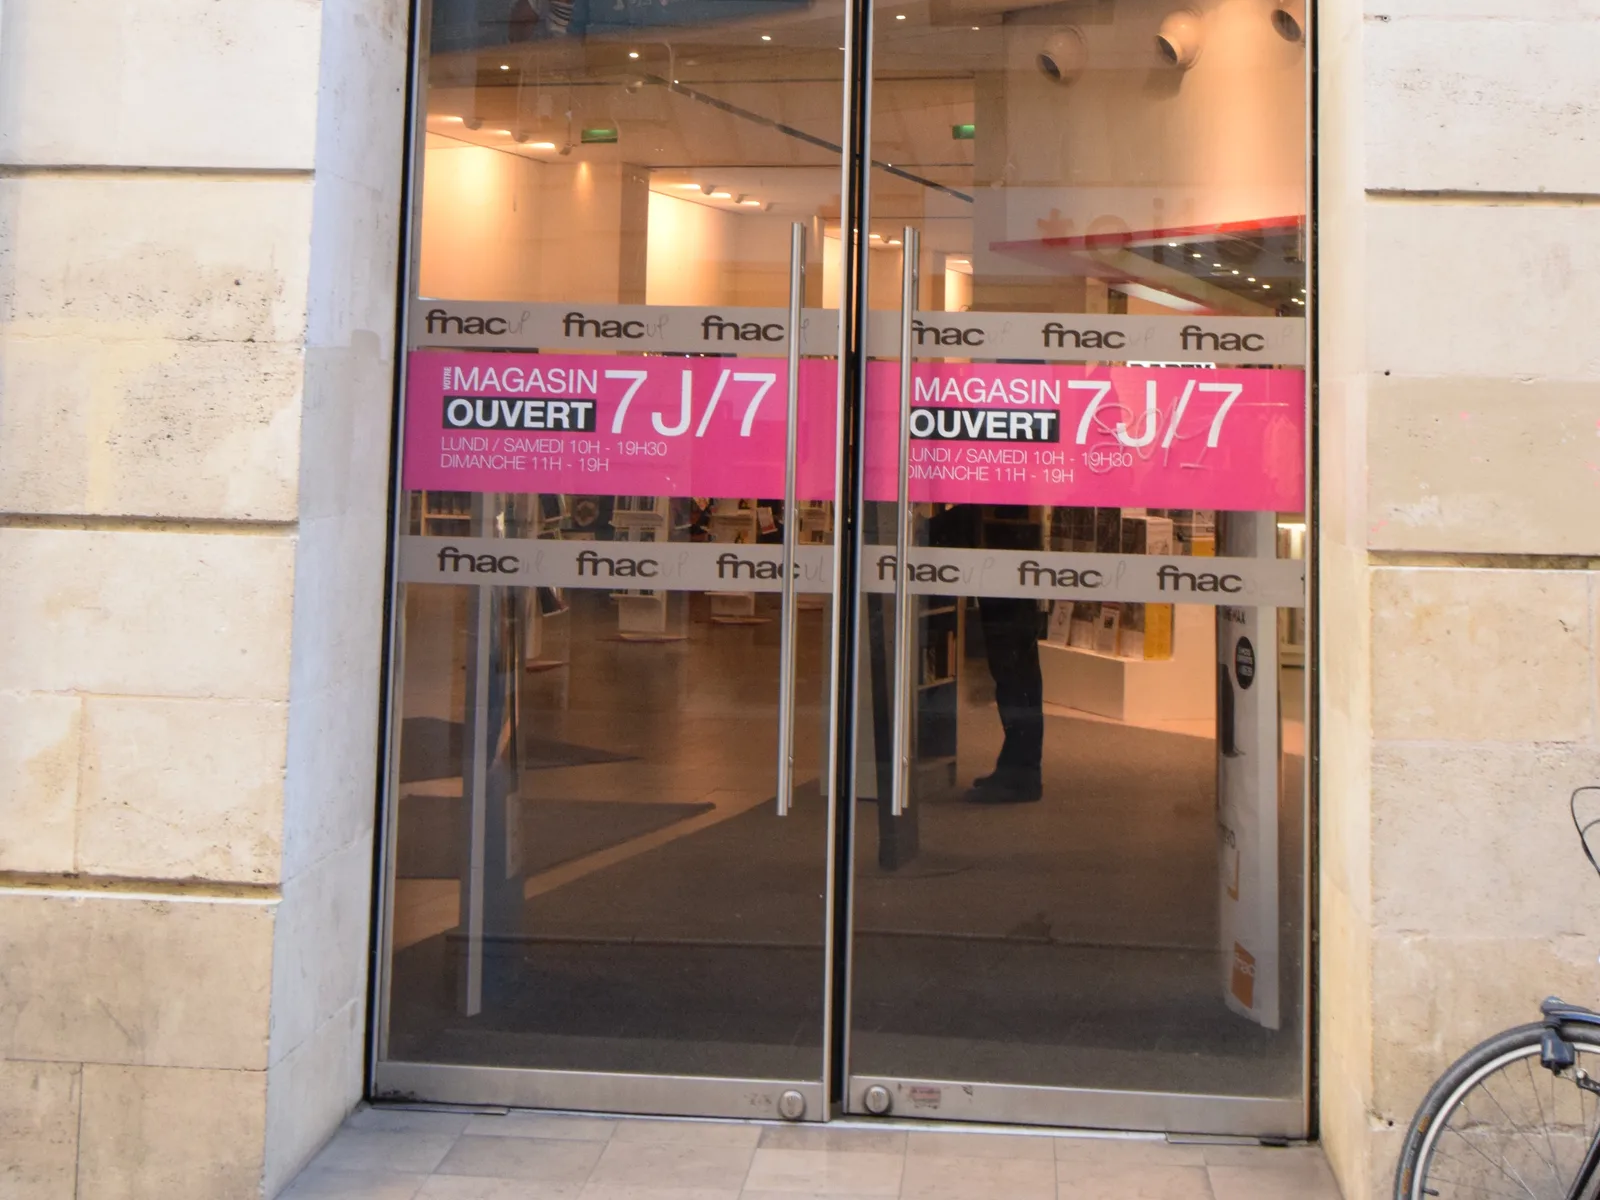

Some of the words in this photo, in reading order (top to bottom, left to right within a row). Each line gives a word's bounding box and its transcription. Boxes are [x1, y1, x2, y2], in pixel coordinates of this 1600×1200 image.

[426, 309, 507, 335] fnac
[562, 311, 645, 339] fnac
[701, 315, 784, 341] fnac
[1042, 322, 1125, 349] fnac
[1180, 325, 1264, 352] fnac
[443, 366, 452, 390] VOTRE
[453, 366, 597, 394] MAGASIN
[915, 376, 1060, 404] MAGASIN
[447, 398, 593, 429] OUVERT
[910, 409, 1056, 440] OUVERT
[441, 436, 488, 452] LUNDI
[503, 437, 563, 454] SAMEDI
[570, 440, 600, 455] 10H
[617, 441, 668, 456] 19H30
[909, 447, 950, 463] UNDI
[966, 448, 1028, 464] SAMEDI
[1034, 450, 1064, 465] 10H
[1081, 452, 1133, 467] 19H30
[441, 453, 525, 470] DIMANCHE
[532, 458, 561, 471] 11H
[579, 458, 609, 472] 19H
[995, 468, 1025, 482] 11H
[1043, 469, 1074, 483] 19H
[437, 547, 519, 574] fnac
[576, 550, 658, 577] fnac
[1017, 560, 1101, 588] fnac
[1157, 565, 1242, 593] fnac
